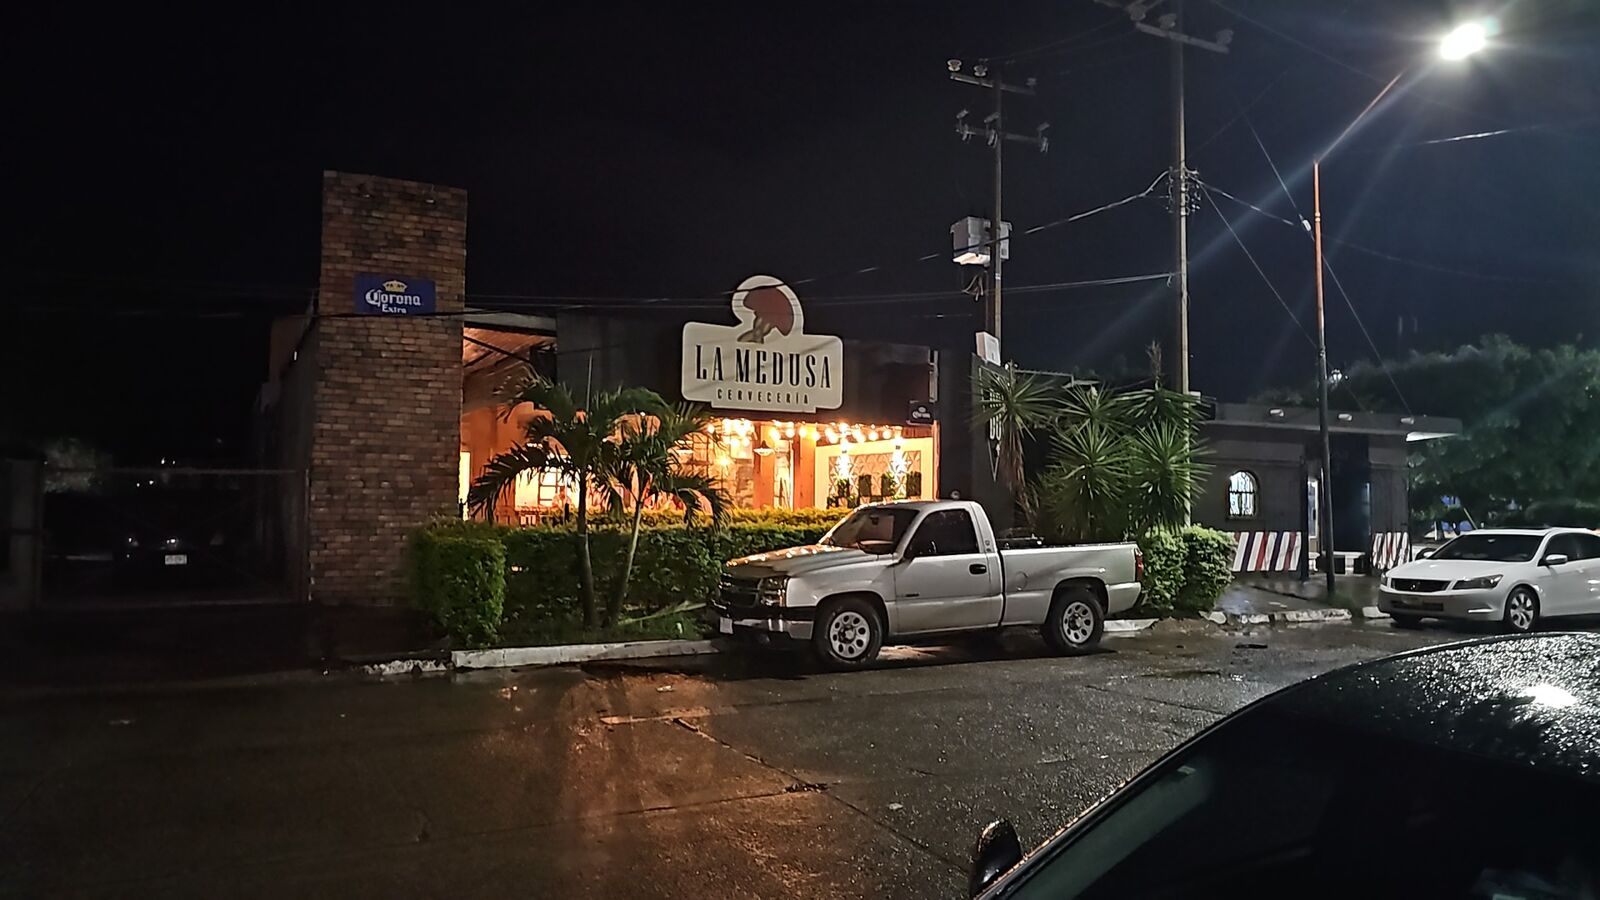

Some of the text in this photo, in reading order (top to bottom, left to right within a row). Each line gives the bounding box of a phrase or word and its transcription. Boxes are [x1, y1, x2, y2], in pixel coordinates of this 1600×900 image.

[365, 288, 422, 307] Corona
[382, 303, 407, 314] Extra
[696, 344, 831, 389] LA MEDUSA
